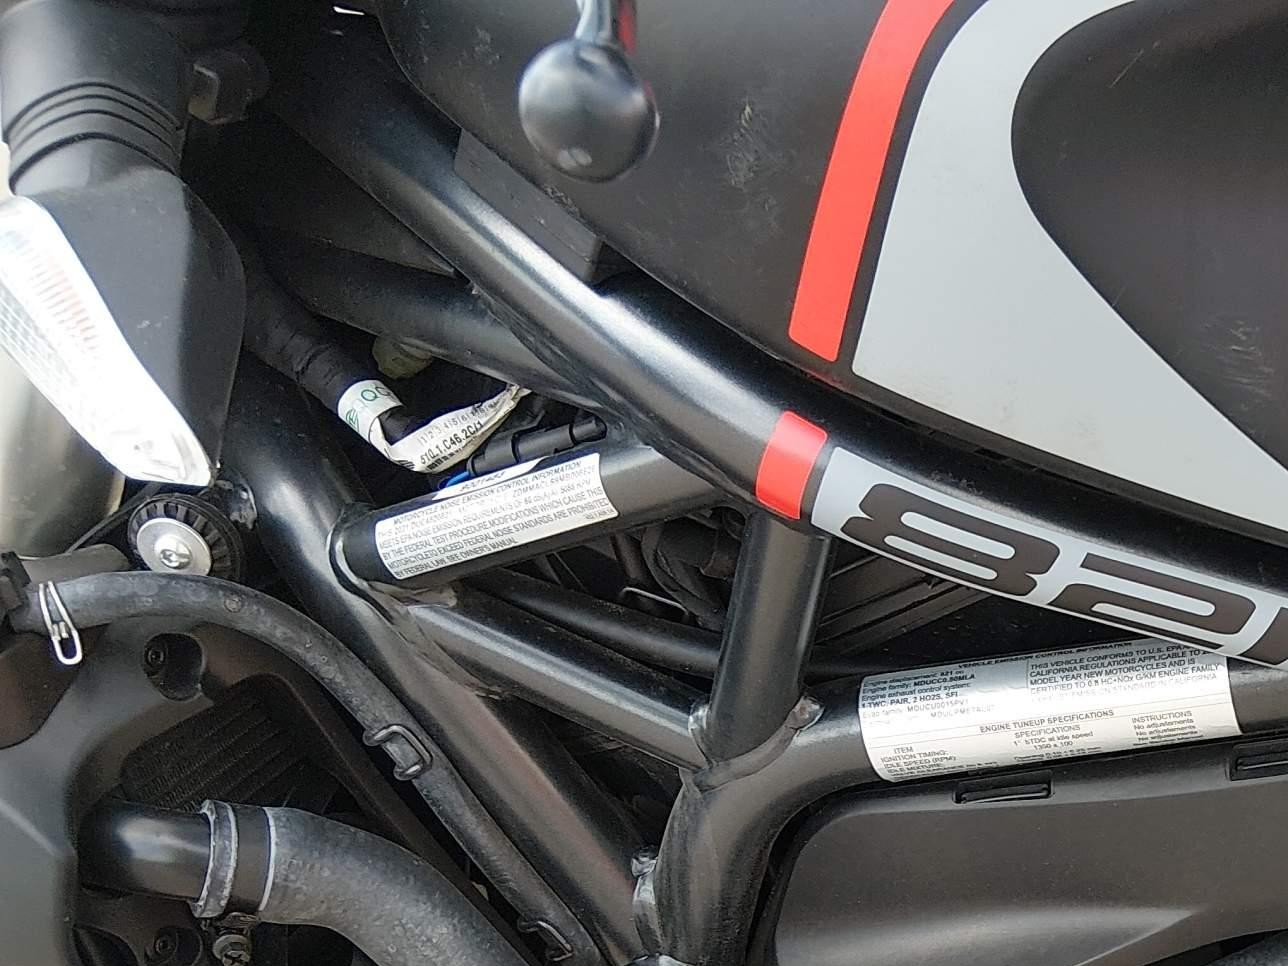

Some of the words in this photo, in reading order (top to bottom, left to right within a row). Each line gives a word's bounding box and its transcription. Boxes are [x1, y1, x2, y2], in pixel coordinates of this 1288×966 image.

[531, 461, 583, 481] INFORMATION
[1029, 665, 1077, 678] CALIFORNIA
[1078, 657, 1136, 671] REGULATIONS
[1136, 650, 1187, 664] APPLICABLE
[1188, 648, 1201, 656] TO
[1030, 662, 1049, 670] THIS
[1050, 657, 1084, 667] VEHICLE
[1086, 650, 1134, 663] CONFORMS
[1135, 648, 1147, 656] TO
[1029, 675, 1058, 686] MODEL
[1059, 672, 1081, 682] YEAR
[1082, 669, 1103, 679] NEW
[1104, 661, 1167, 676] MOTORCYCLES
[1167, 658, 1186, 668] AND
[1029, 682, 1073, 695] CERTIFIED
[1074, 680, 1086, 689] TO
[1157, 666, 1189, 678] ENGINE
[1191, 662, 1220, 673] FAMILY
[861, 685, 887, 695] Engine
[861, 693, 886, 702] Engine
[979, 722, 1011, 733] ENGINE
[1012, 718, 1045, 729] TUNEUP
[1046, 708, 1114, 724] SPECIFICATIONS
[1131, 709, 1192, 724] INSTRUCTIONS
[1014, 723, 1080, 739] SPECIFICATIONS
[893, 745, 913, 754] ITEM
